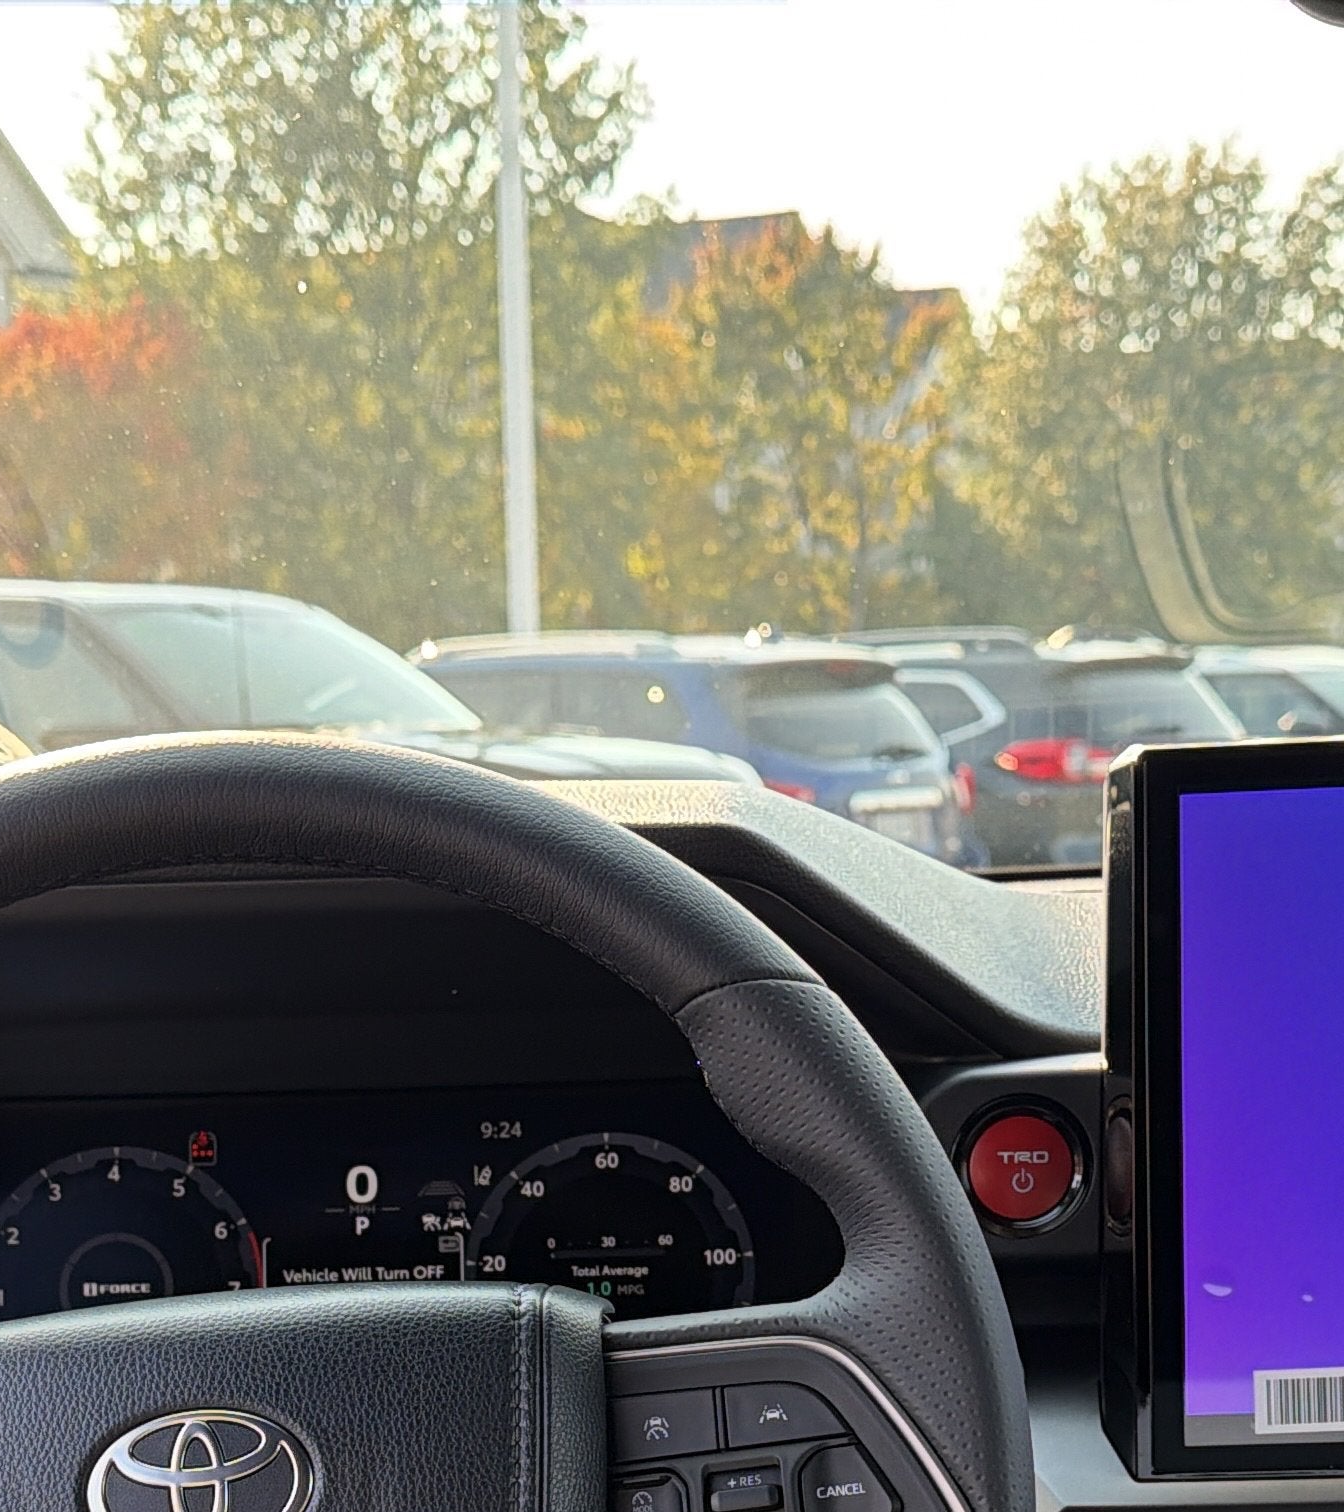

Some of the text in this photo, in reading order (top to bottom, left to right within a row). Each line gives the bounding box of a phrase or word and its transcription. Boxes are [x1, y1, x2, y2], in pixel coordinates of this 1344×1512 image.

[480, 1121, 523, 1140] 9:24
[594, 1151, 619, 1169] 60
[996, 1150, 1050, 1165] TRD
[107, 1164, 121, 1183] 4
[48, 1183, 62, 1202] 3
[172, 1178, 186, 1198] 5
[346, 1165, 379, 1204] 0
[520, 1180, 545, 1198] 40
[668, 1175, 693, 1193] 80
[214, 1220, 228, 1240] 6
[355, 1216, 370, 1236] P
[6, 1227, 20, 1245] 2
[601, 1235, 616, 1248] 30
[658, 1233, 674, 1247] 60
[482, 1255, 506, 1272] 20
[704, 1248, 737, 1266] 100
[283, 1265, 444, 1283] Vehicle Will Turn OFF
[571, 1265, 649, 1281] Total Average
[617, 1284, 645, 1296] MPG
[816, 1482, 866, 1500] CANCEL
